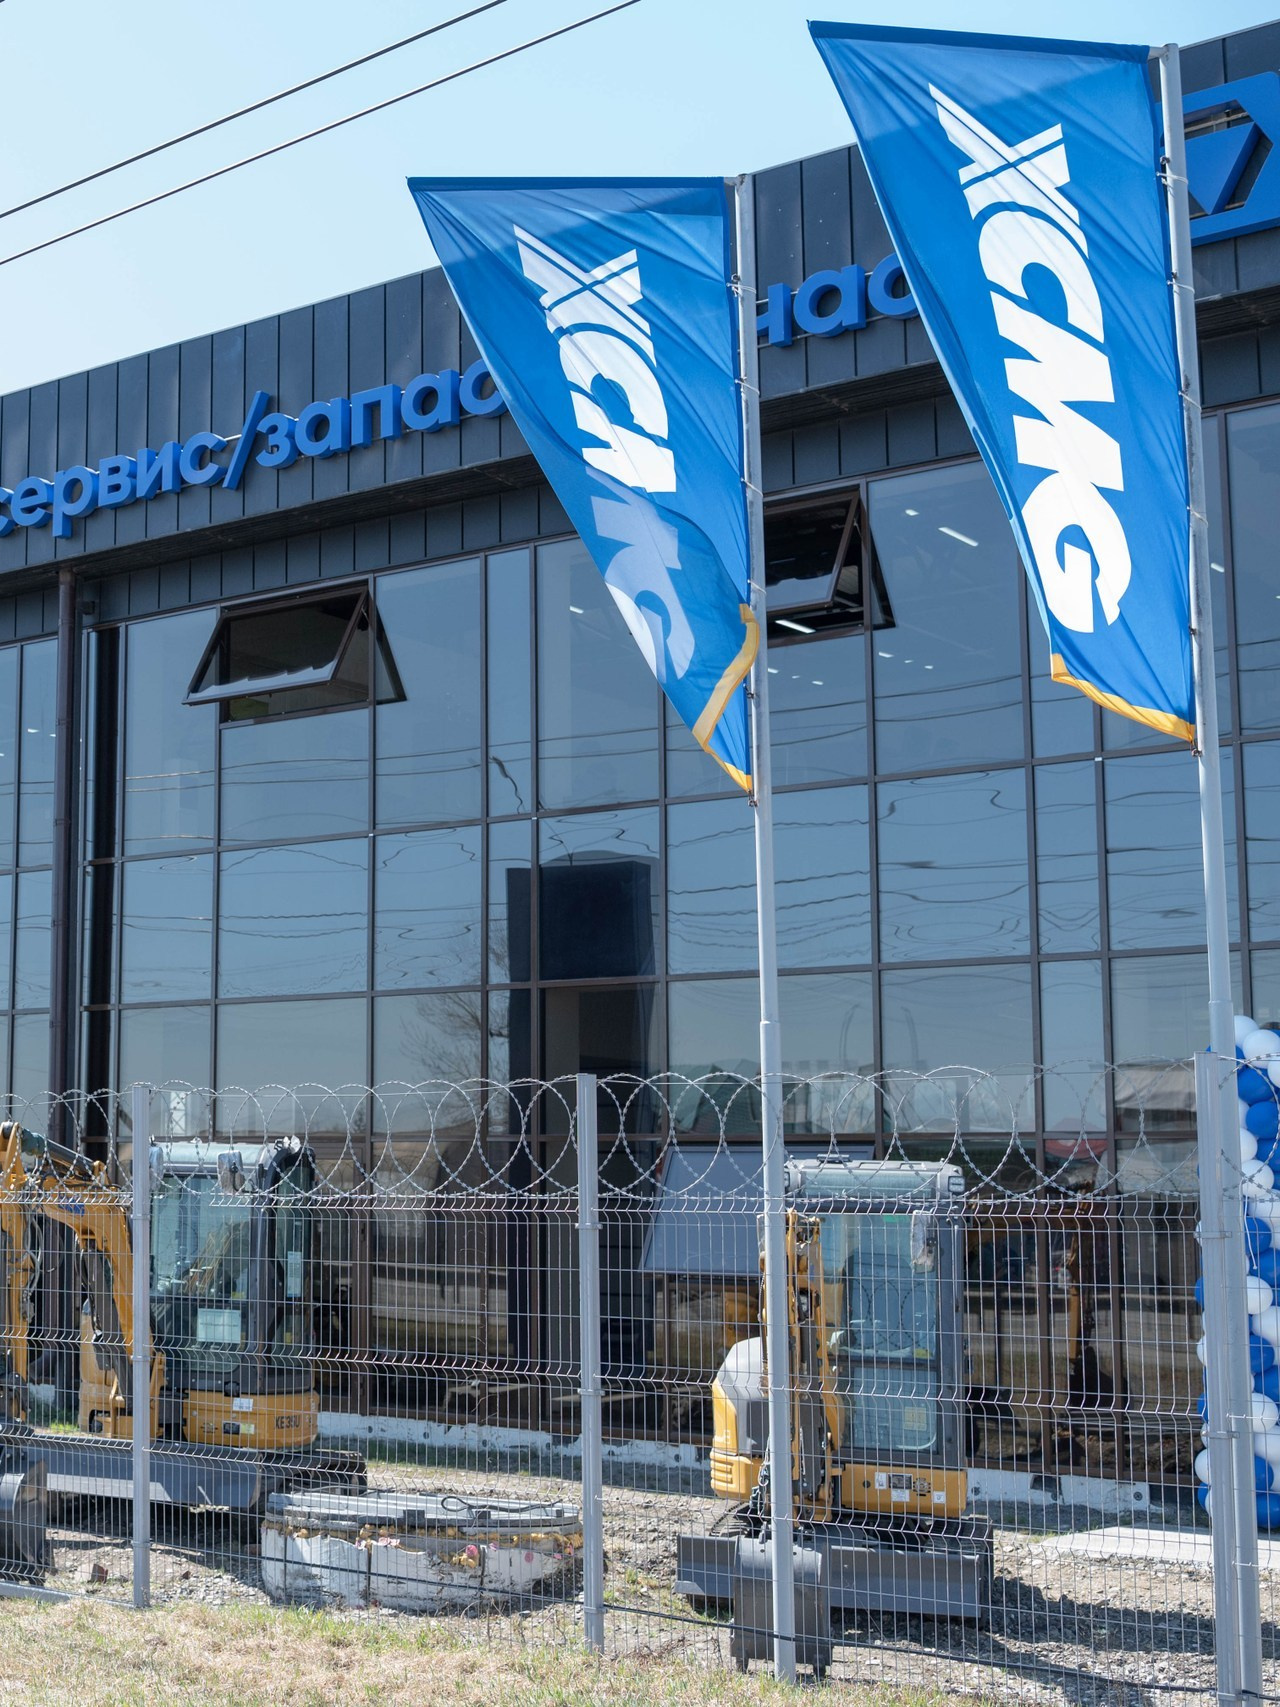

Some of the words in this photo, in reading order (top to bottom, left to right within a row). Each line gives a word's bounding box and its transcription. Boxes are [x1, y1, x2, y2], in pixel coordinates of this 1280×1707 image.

[513, 223, 695, 684] XCMG
[756, 252, 920, 348] час
[929, 83, 1131, 633] XCMG
